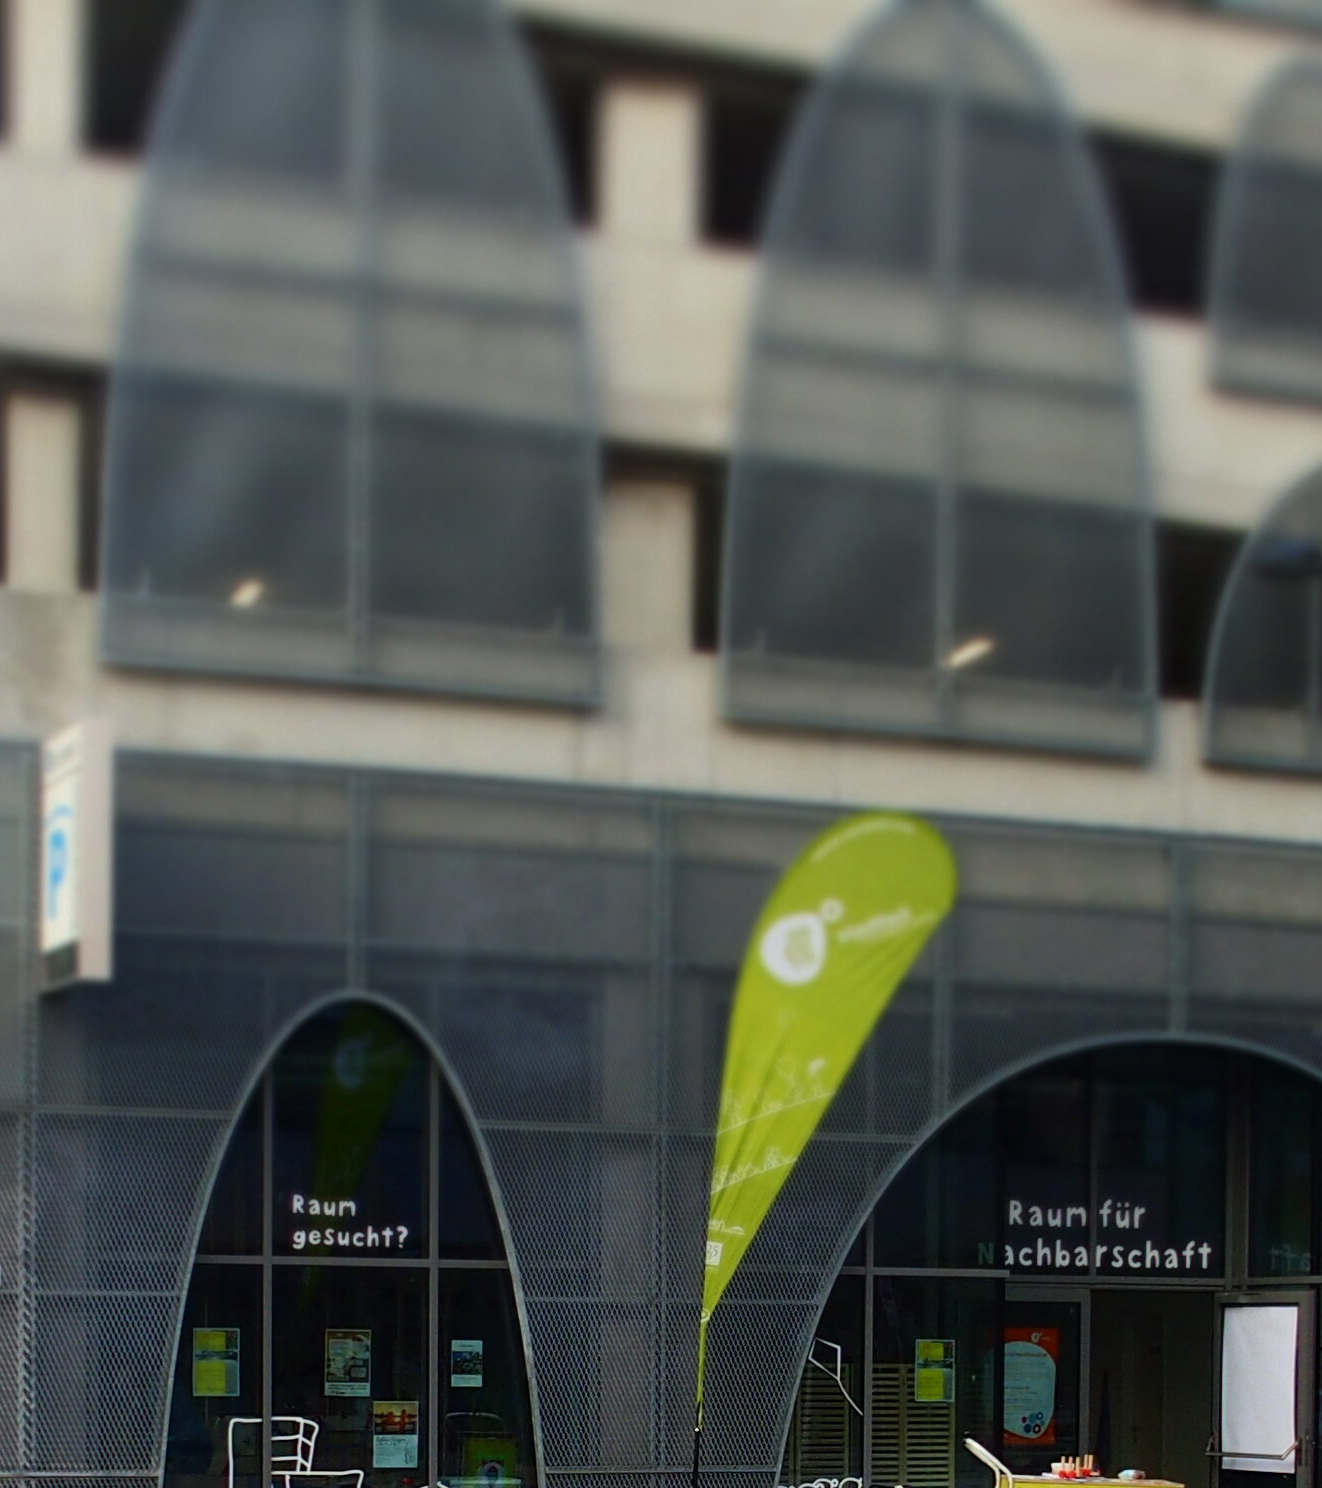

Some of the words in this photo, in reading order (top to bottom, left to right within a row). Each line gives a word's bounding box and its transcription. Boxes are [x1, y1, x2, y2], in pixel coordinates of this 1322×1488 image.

[292, 1193, 356, 1217] Raum
[1008, 1199, 1087, 1228] Raum
[1098, 1199, 1146, 1230] für
[292, 1225, 409, 1250] gesucht?
